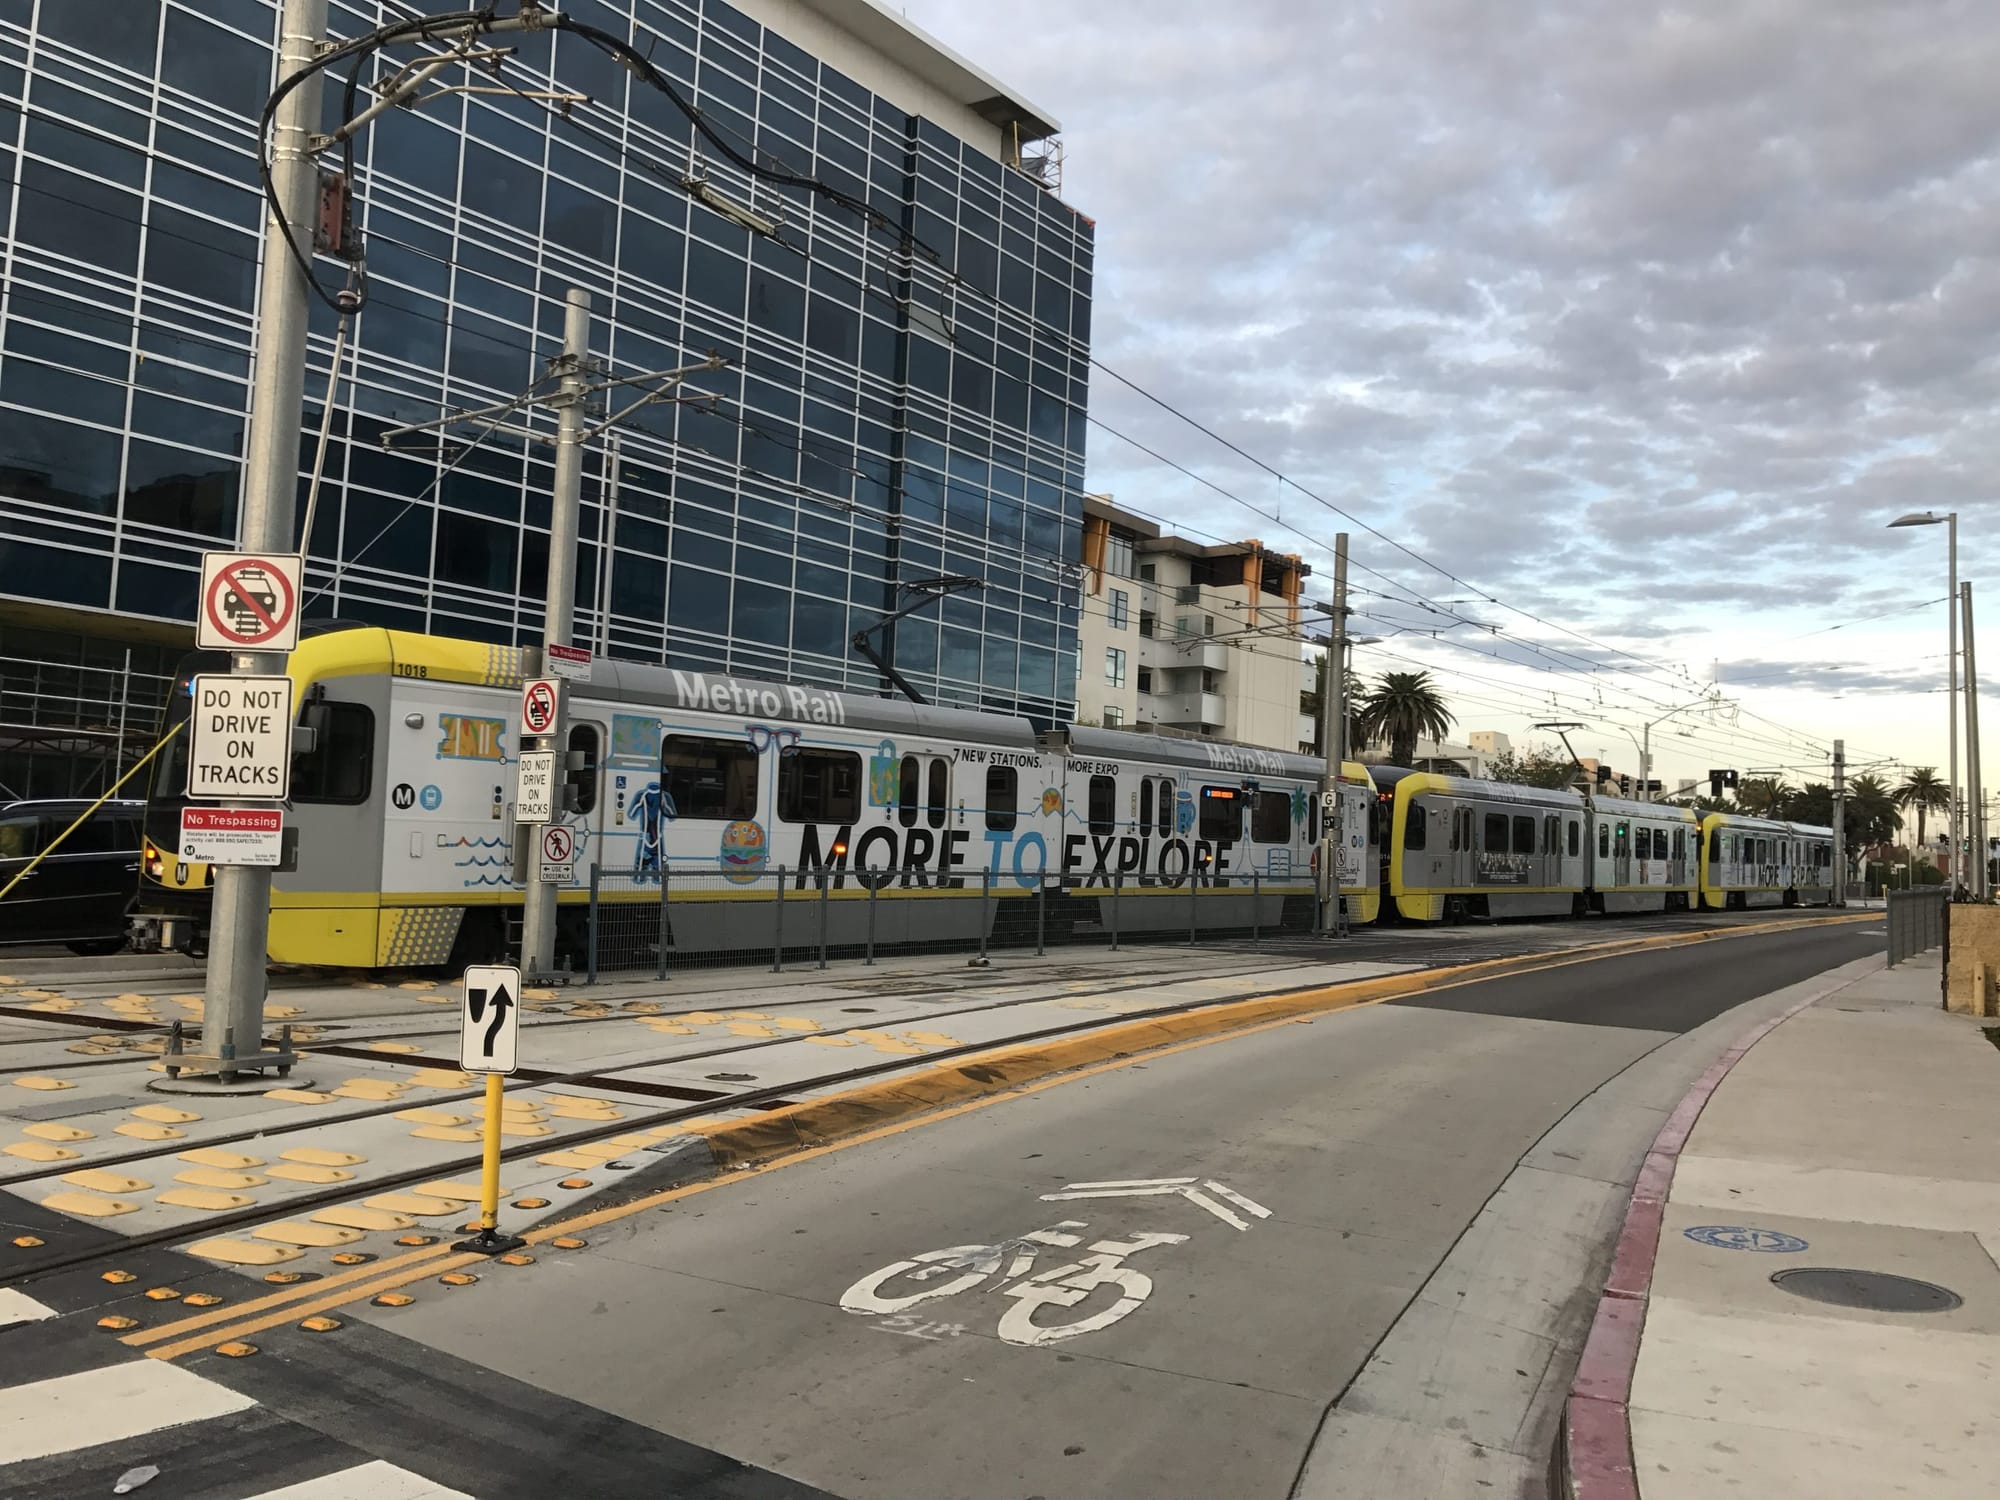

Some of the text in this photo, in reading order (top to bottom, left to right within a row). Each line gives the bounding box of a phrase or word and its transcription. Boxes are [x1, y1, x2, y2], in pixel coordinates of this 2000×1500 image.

[398, 664, 427, 677] 1018
[204, 690, 282, 709] DO NOT
[672, 670, 845, 725] Metro Rail
[212, 715, 271, 734] DRIVE
[227, 740, 254, 759] ON
[521, 759, 550, 771] DO NOT
[953, 748, 1119, 776] 7 NEW STATIONS. MORE EXPO
[1204, 743, 1286, 776] Metro Rail
[199, 765, 279, 784] TRACKS
[523, 774, 546, 785] DRIVE
[394, 786, 414, 807] M
[528, 789, 539, 800] ON
[1325, 794, 1332, 805] G
[518, 803, 548, 815] TRACKS
[187, 814, 277, 828] No Trespassing
[795, 824, 1232, 889] MORE TO EXPLORE
